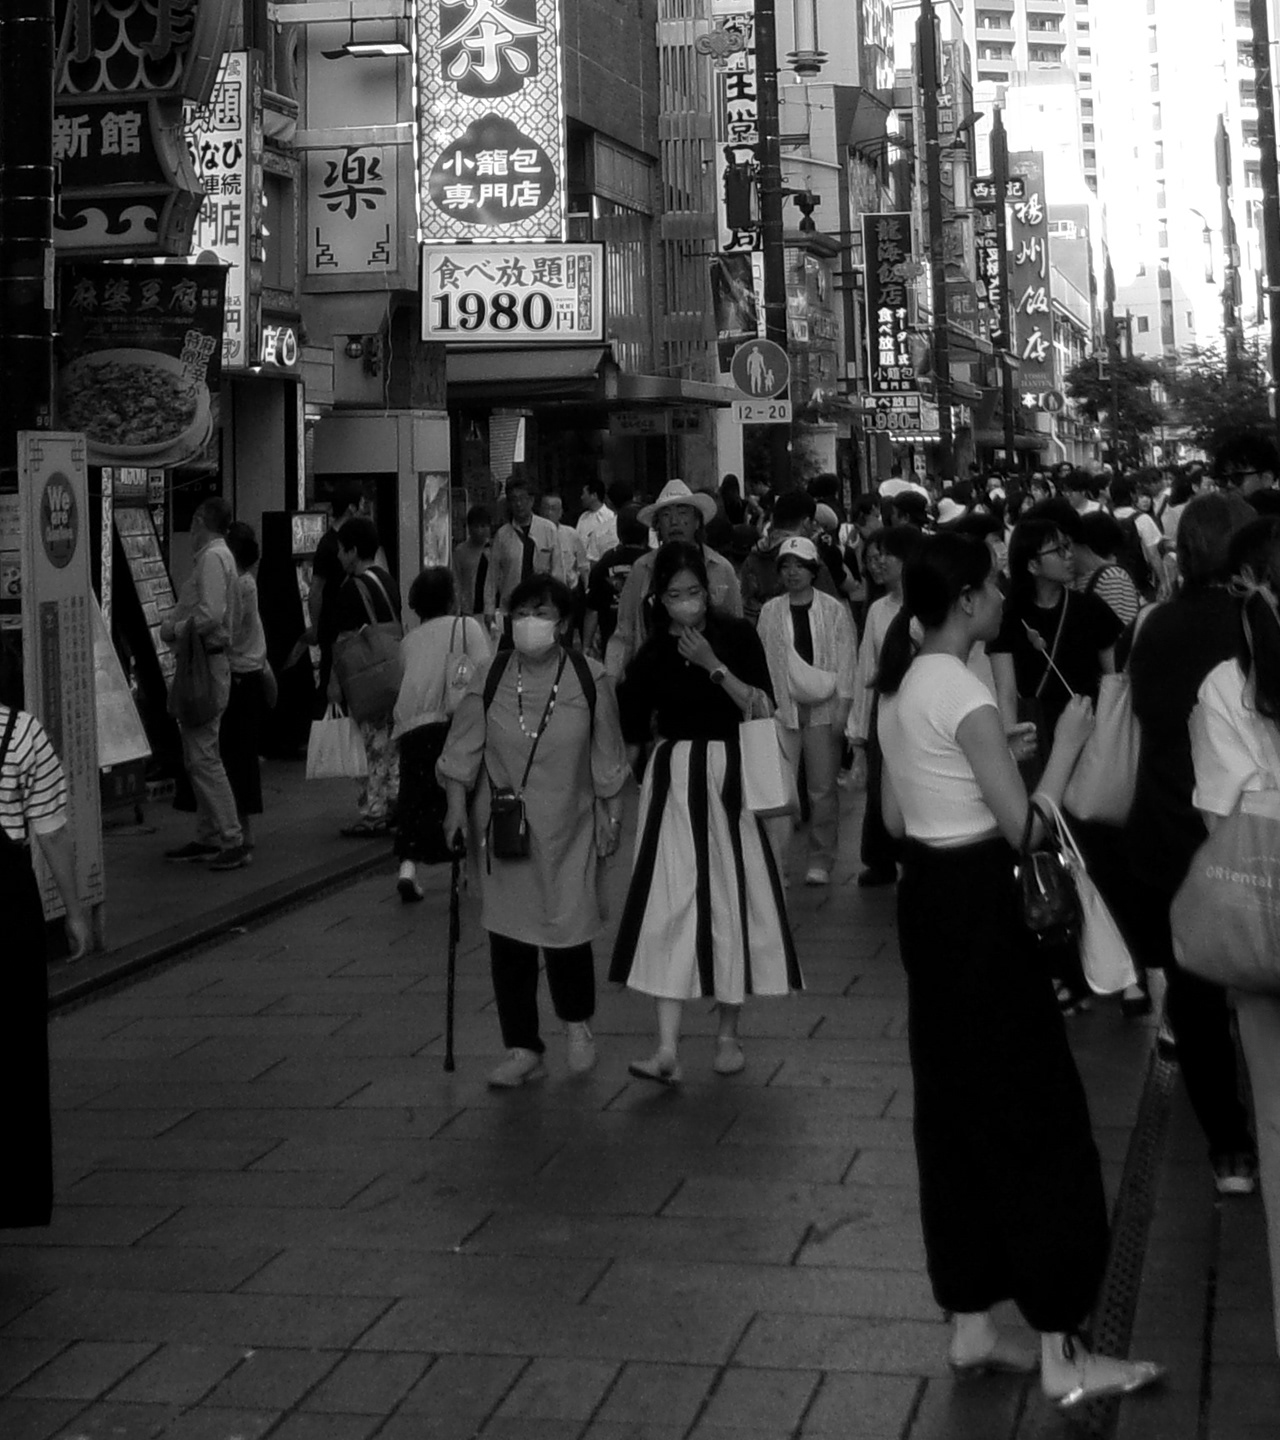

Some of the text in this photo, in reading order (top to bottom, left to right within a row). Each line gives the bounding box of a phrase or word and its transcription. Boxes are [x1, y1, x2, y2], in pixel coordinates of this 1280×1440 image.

[53, 111, 142, 160] 新館
[442, 148, 541, 176] 小籠包
[318, 147, 387, 220] 楽
[442, 180, 541, 208] 専門店
[432, 255, 564, 290] 食べ放題
[431, 290, 555, 332] 1980
